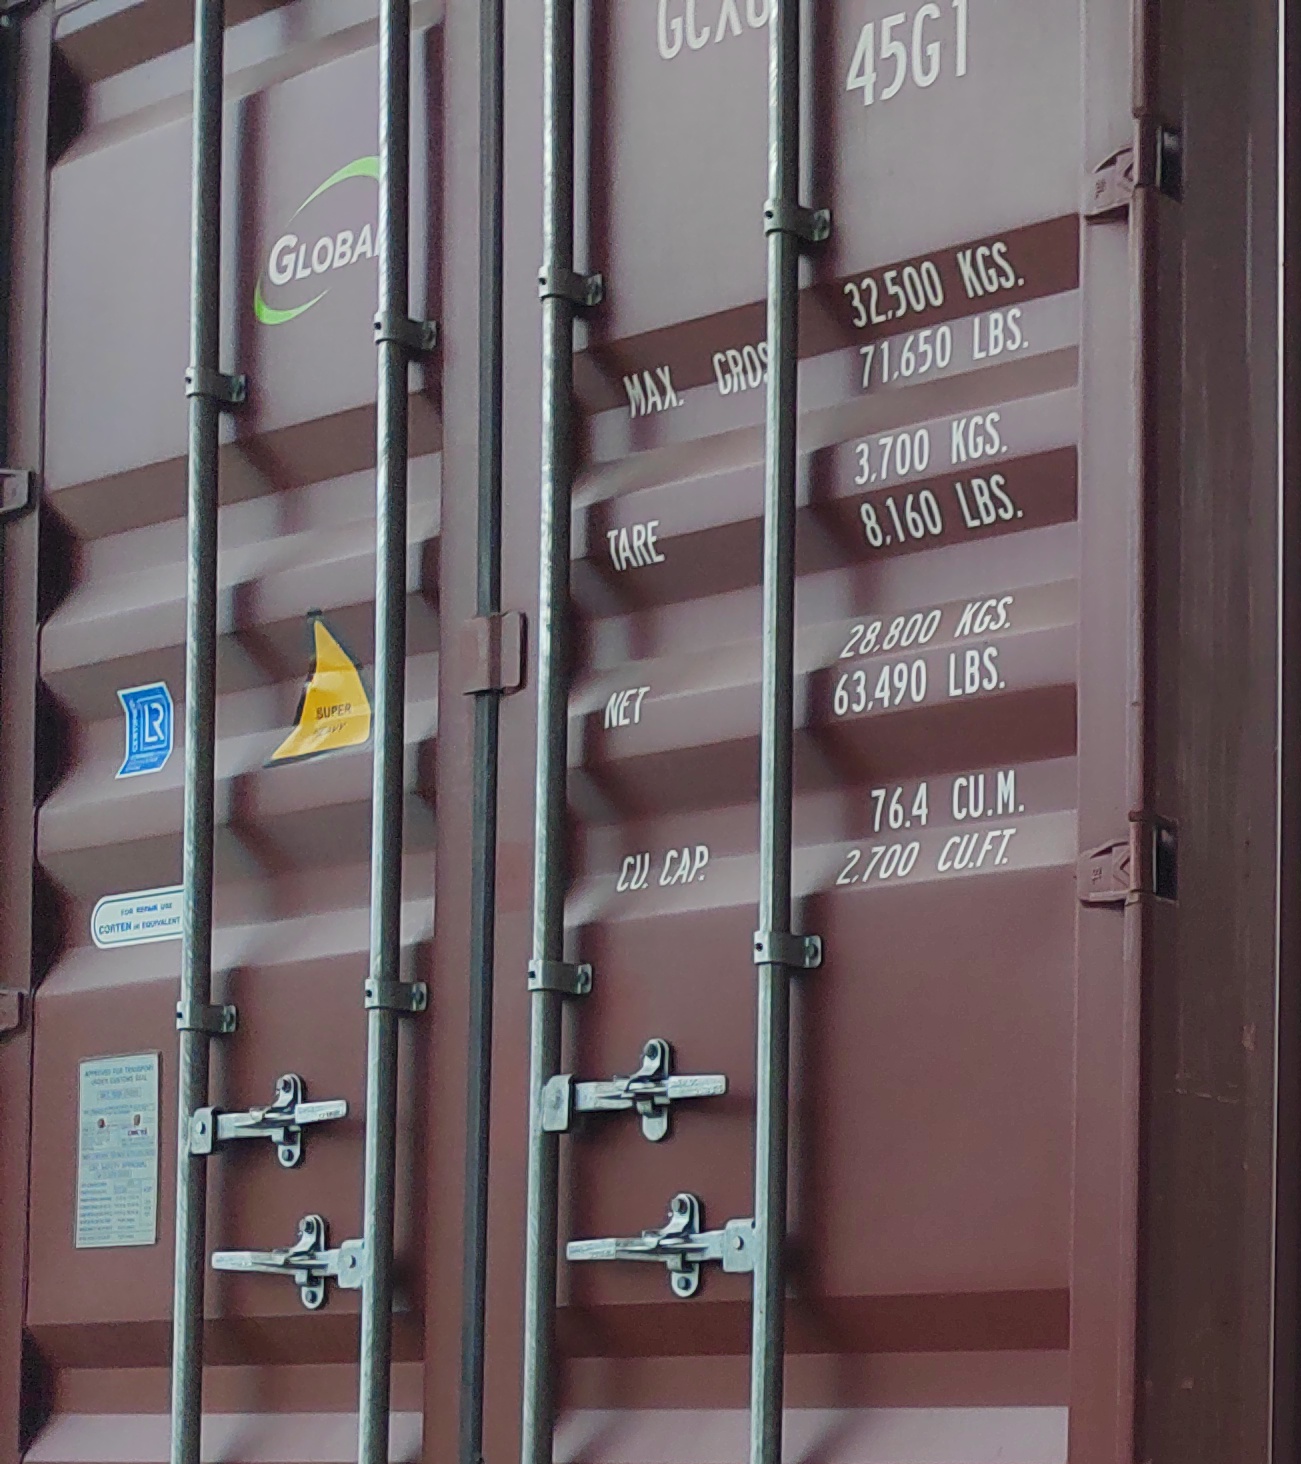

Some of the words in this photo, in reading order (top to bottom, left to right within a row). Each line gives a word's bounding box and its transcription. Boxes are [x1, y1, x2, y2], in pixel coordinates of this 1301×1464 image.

[846, 0, 969, 106] 45G1
[268, 223, 380, 285] GLOBA
[957, 241, 1025, 299] KGS.
[972, 307, 1029, 361] LBS.
[623, 365, 684, 419] MAX.
[951, 411, 1008, 465] KGS.
[955, 473, 1024, 529] LBS.
[607, 519, 665, 571] TARE
[953, 595, 1014, 638] KGS.
[948, 646, 1006, 697] LBS.
[316, 703, 352, 720] SUPER
[603, 686, 650, 729] NET
[871, 782, 928, 833] 76.4
[659, 845, 709, 886] CAP.
[99, 922, 132, 934] CORTEN
